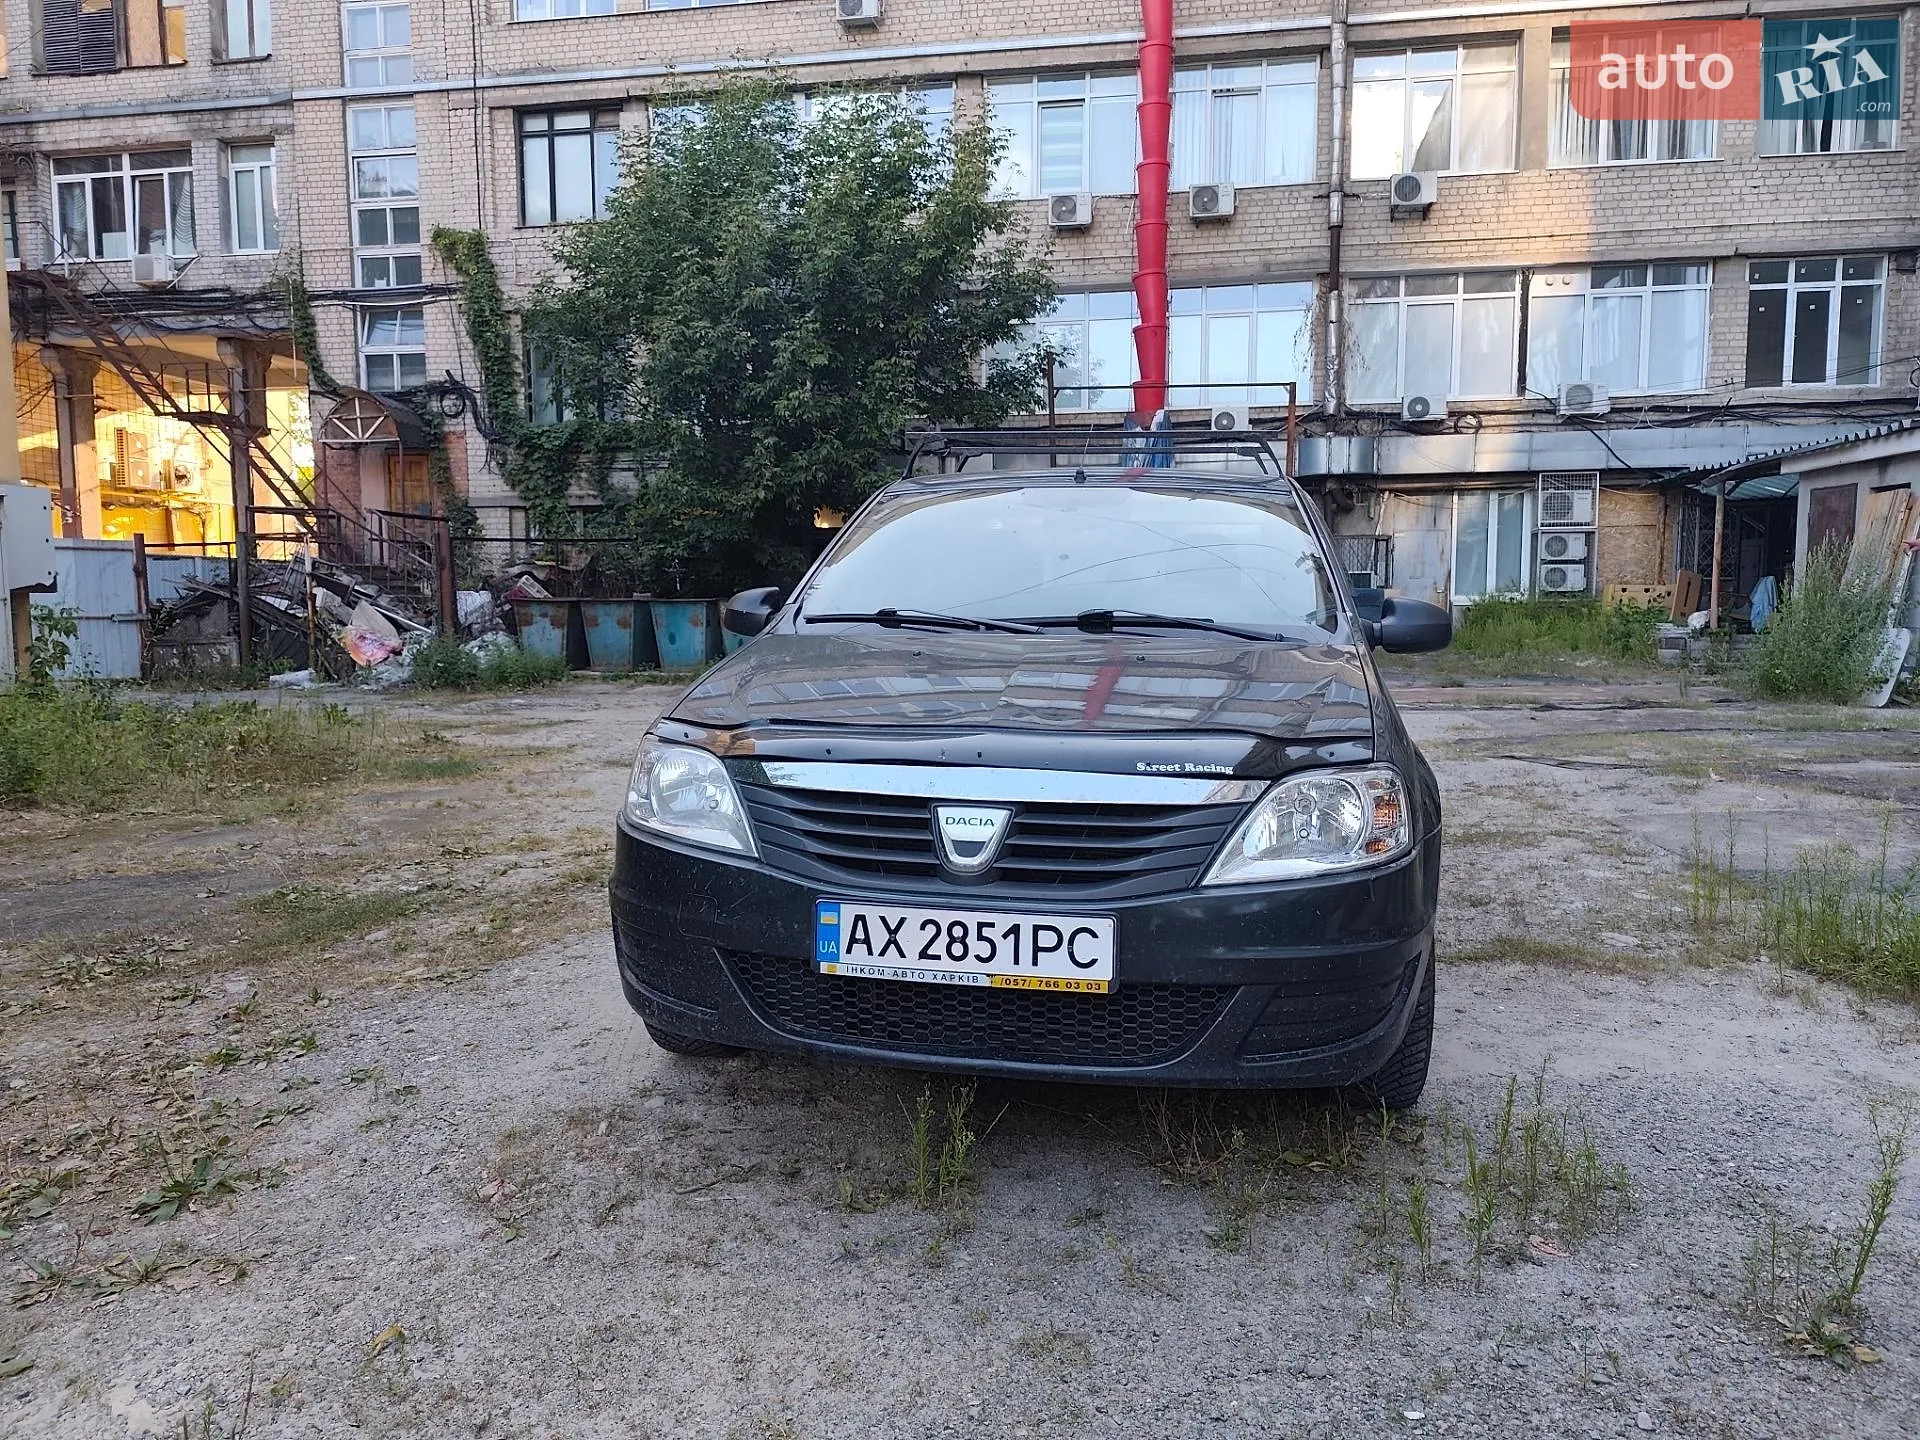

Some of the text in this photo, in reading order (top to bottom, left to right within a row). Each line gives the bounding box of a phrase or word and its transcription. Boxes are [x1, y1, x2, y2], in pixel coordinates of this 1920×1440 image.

[1184, 763, 1234, 775] Racing
[945, 816, 996, 827] DACIA
[819, 940, 838, 954] UA
[846, 965, 980, 984] ІНКОМ-АВТО ХАРКІВ
[1037, 979, 1060, 989] 766
[1065, 981, 1081, 990] 03
[1086, 982, 1101, 991] 03
